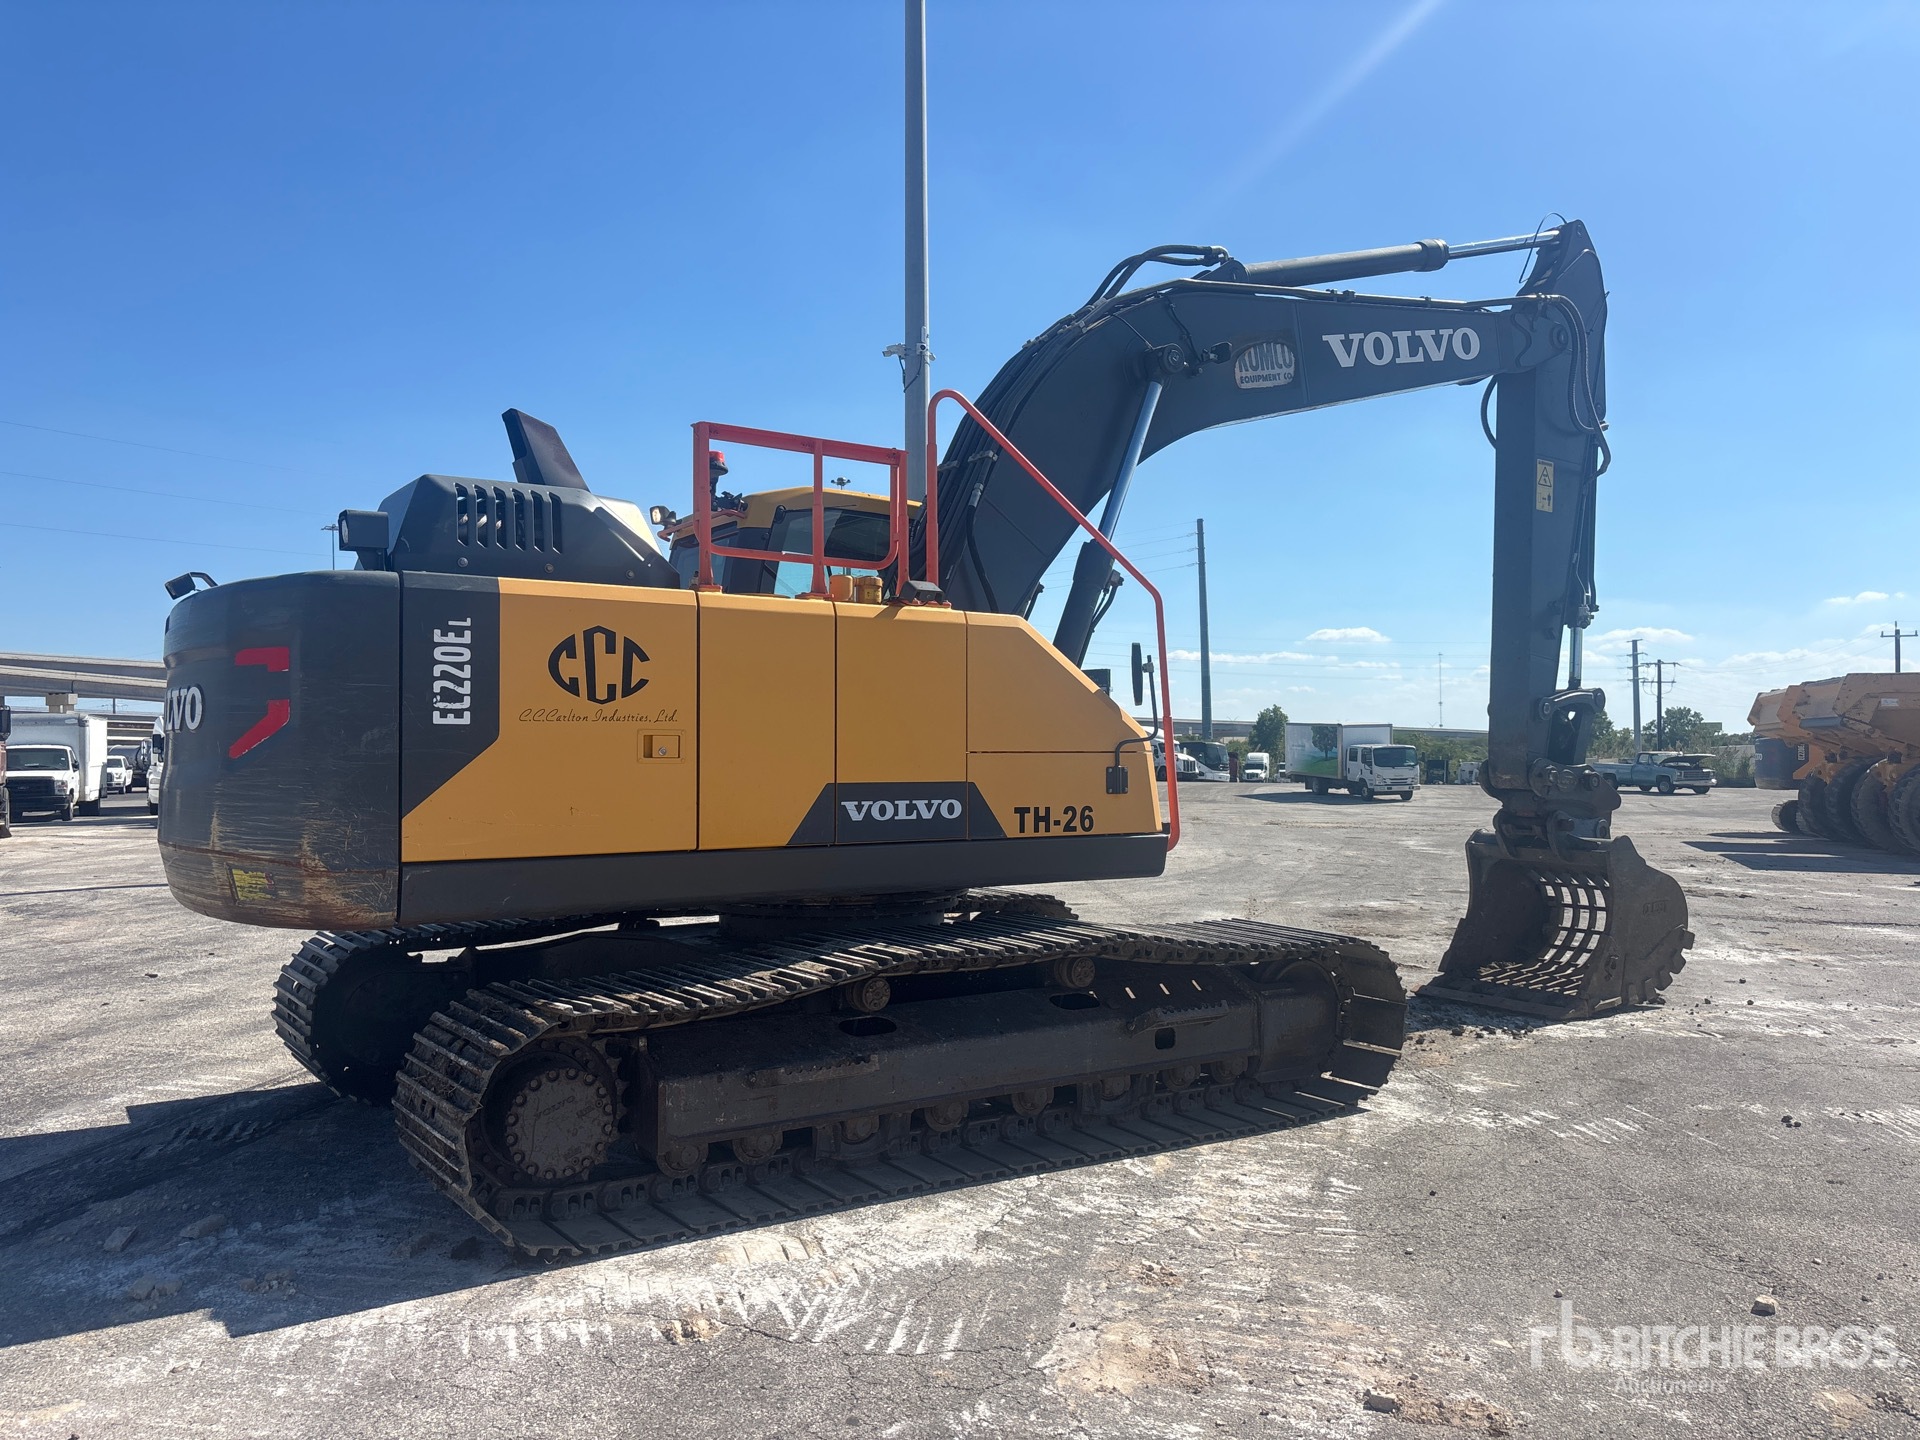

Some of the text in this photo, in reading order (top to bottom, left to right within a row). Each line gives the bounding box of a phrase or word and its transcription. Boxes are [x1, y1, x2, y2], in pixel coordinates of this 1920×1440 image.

[1322, 327, 1480, 368] VOLVO
[1240, 373, 1281, 384] EQUIPMENT
[547, 625, 650, 705] CCC
[653, 709, 678, 723] Ltd.
[841, 799, 962, 821] VOLVO
[1014, 806, 1094, 834] TH-26
